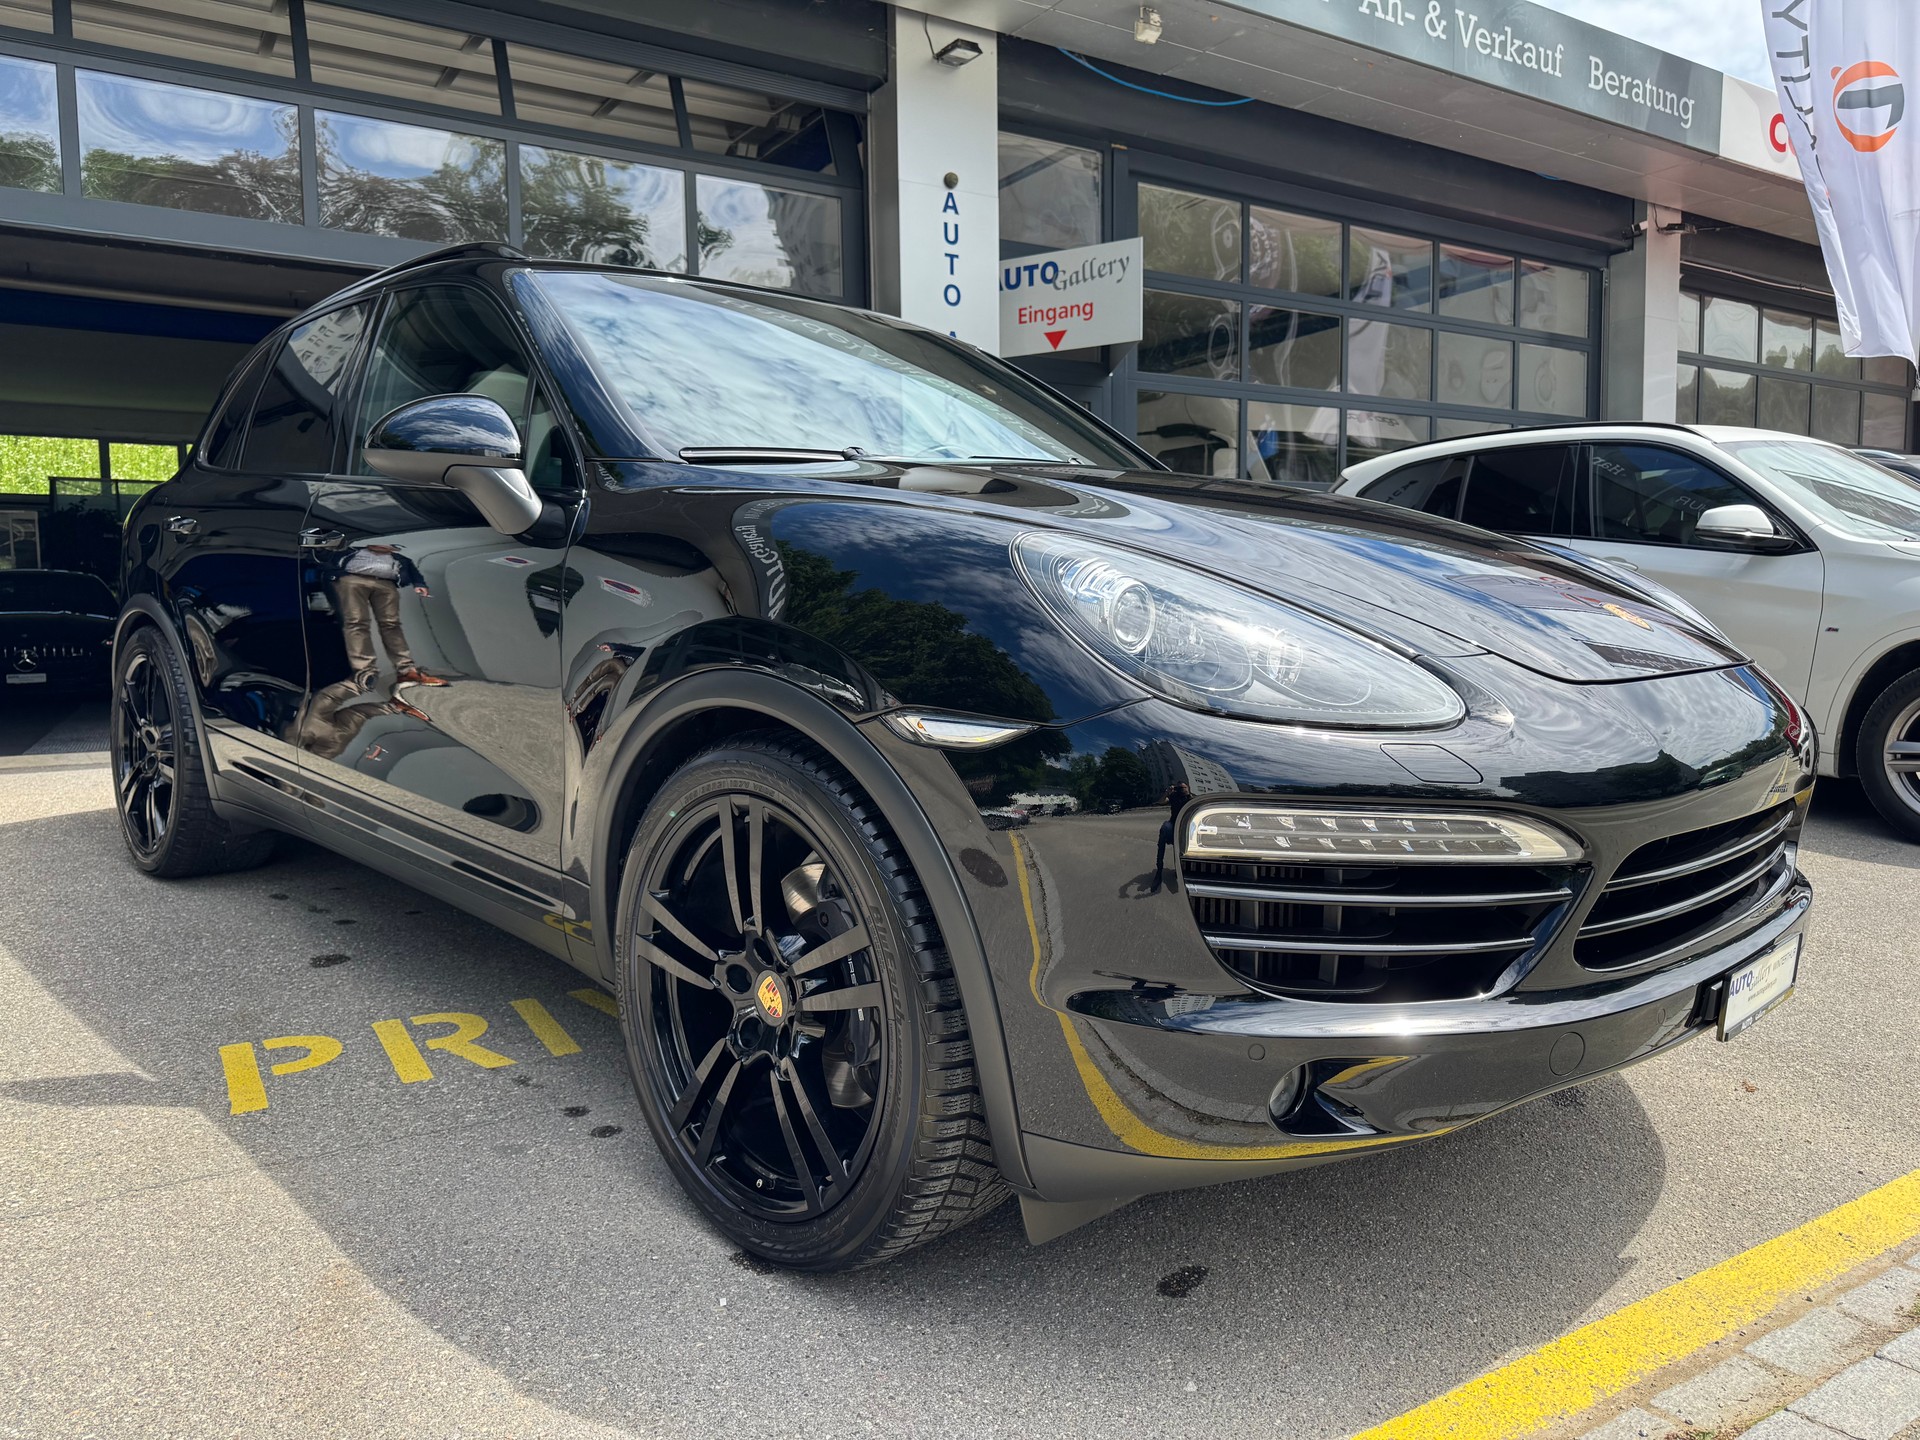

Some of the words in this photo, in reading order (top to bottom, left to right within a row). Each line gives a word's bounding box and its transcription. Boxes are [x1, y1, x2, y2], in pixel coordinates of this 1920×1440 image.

[1424, 0, 1447, 40] &
[1455, 9, 1564, 79] Verkauf
[1588, 55, 1695, 129] Beratung
[1018, 302, 1094, 326] Eingang
